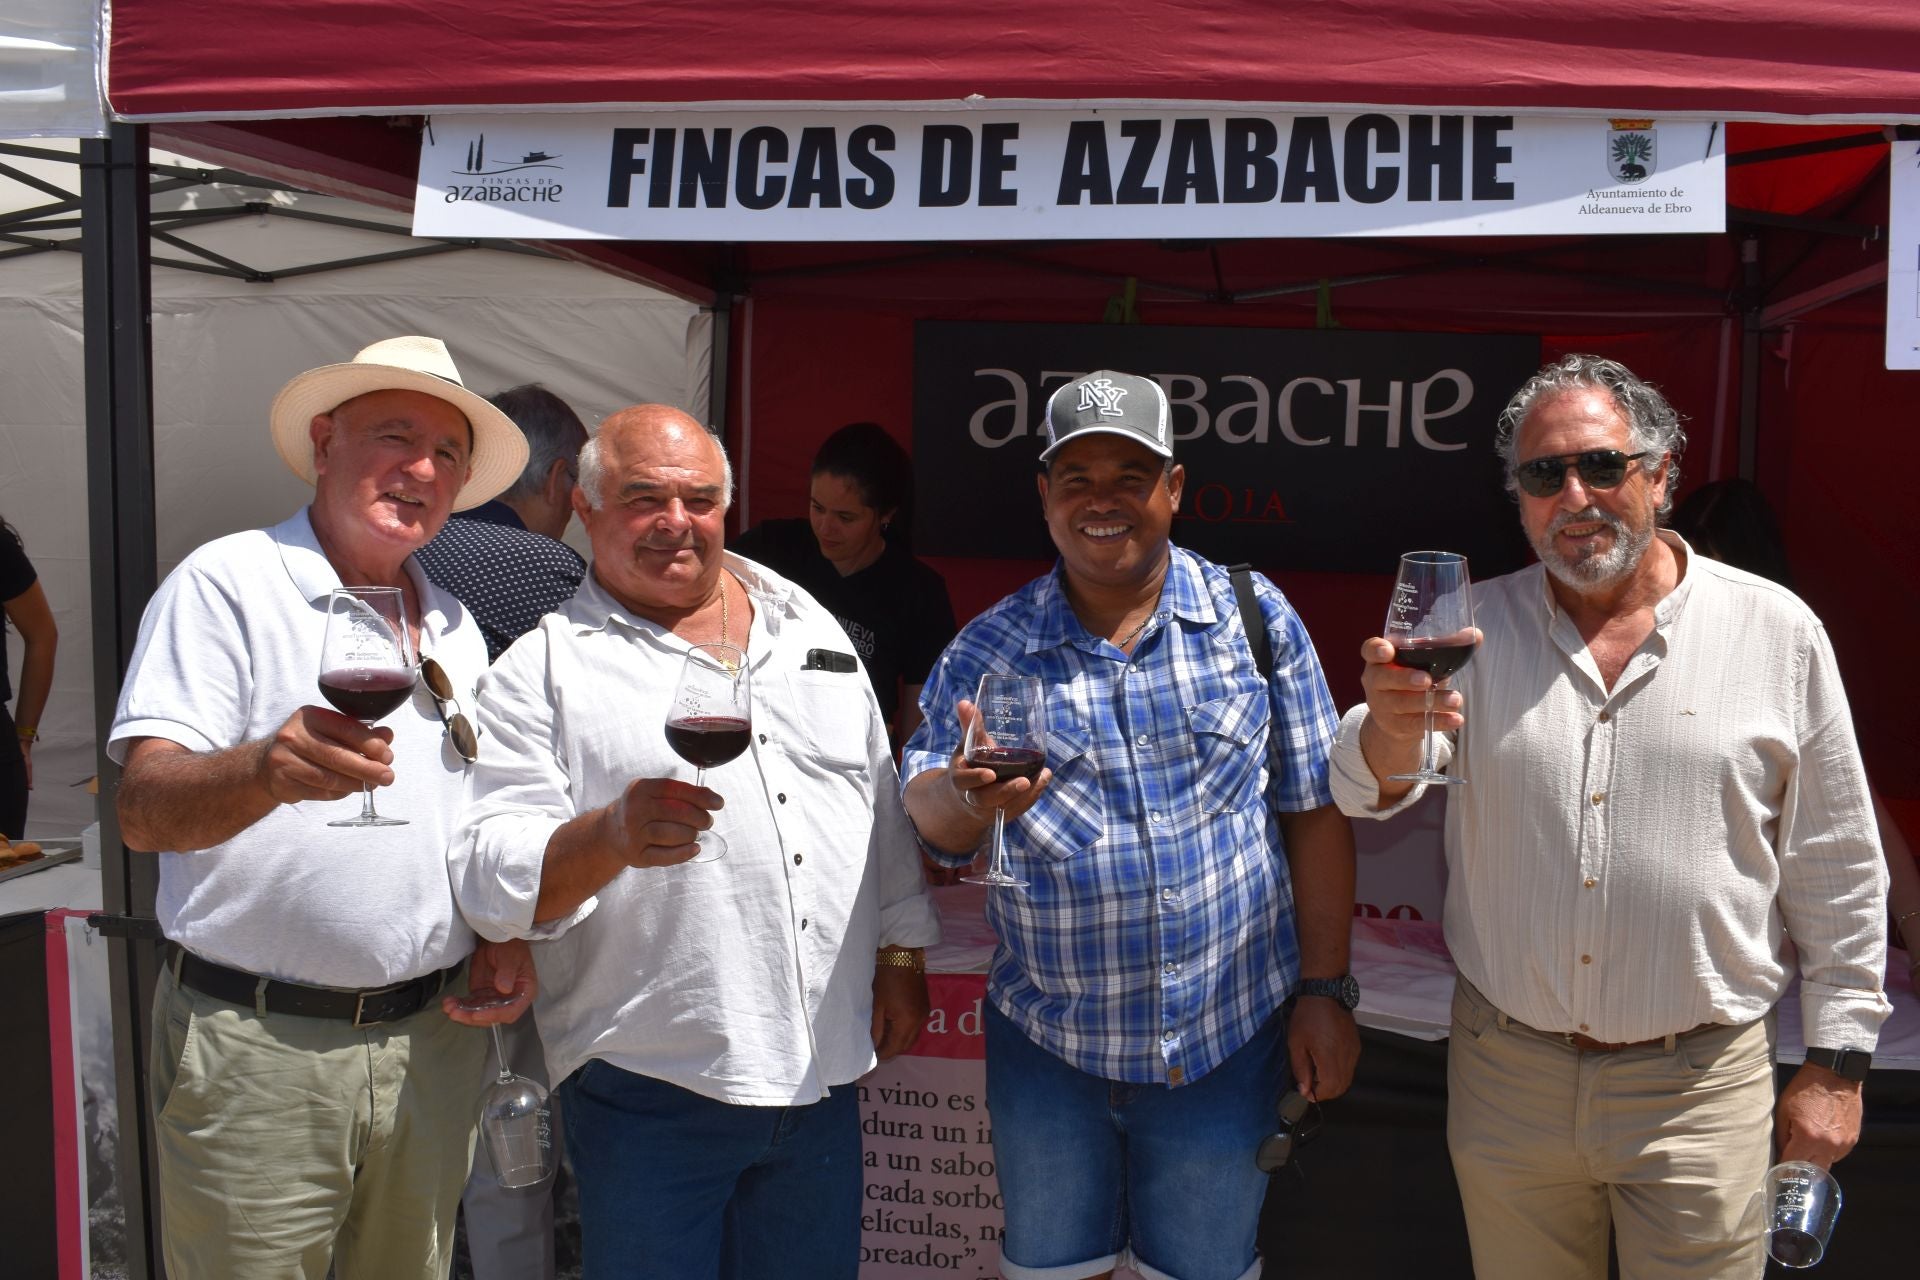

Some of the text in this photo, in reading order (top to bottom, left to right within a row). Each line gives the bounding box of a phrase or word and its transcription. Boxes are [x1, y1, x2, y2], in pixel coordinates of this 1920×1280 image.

[607, 114, 1515, 210] FINCAS DE AZABACHE
[482, 177, 531, 185] FINCAS
[1586, 187, 1684, 202] Ayuntamiento de
[1578, 203, 1692, 215] Aldeanueva de Ebro
[1076, 378, 1128, 417] NY
[834, 614, 875, 644] NUEVA
[878, 1081, 939, 1109] vino
[947, 1093, 976, 1112] es
[862, 1110, 925, 1140] dura
[931, 1124, 968, 1144] un
[886, 1152, 922, 1172] un
[865, 1178, 926, 1206] cada
